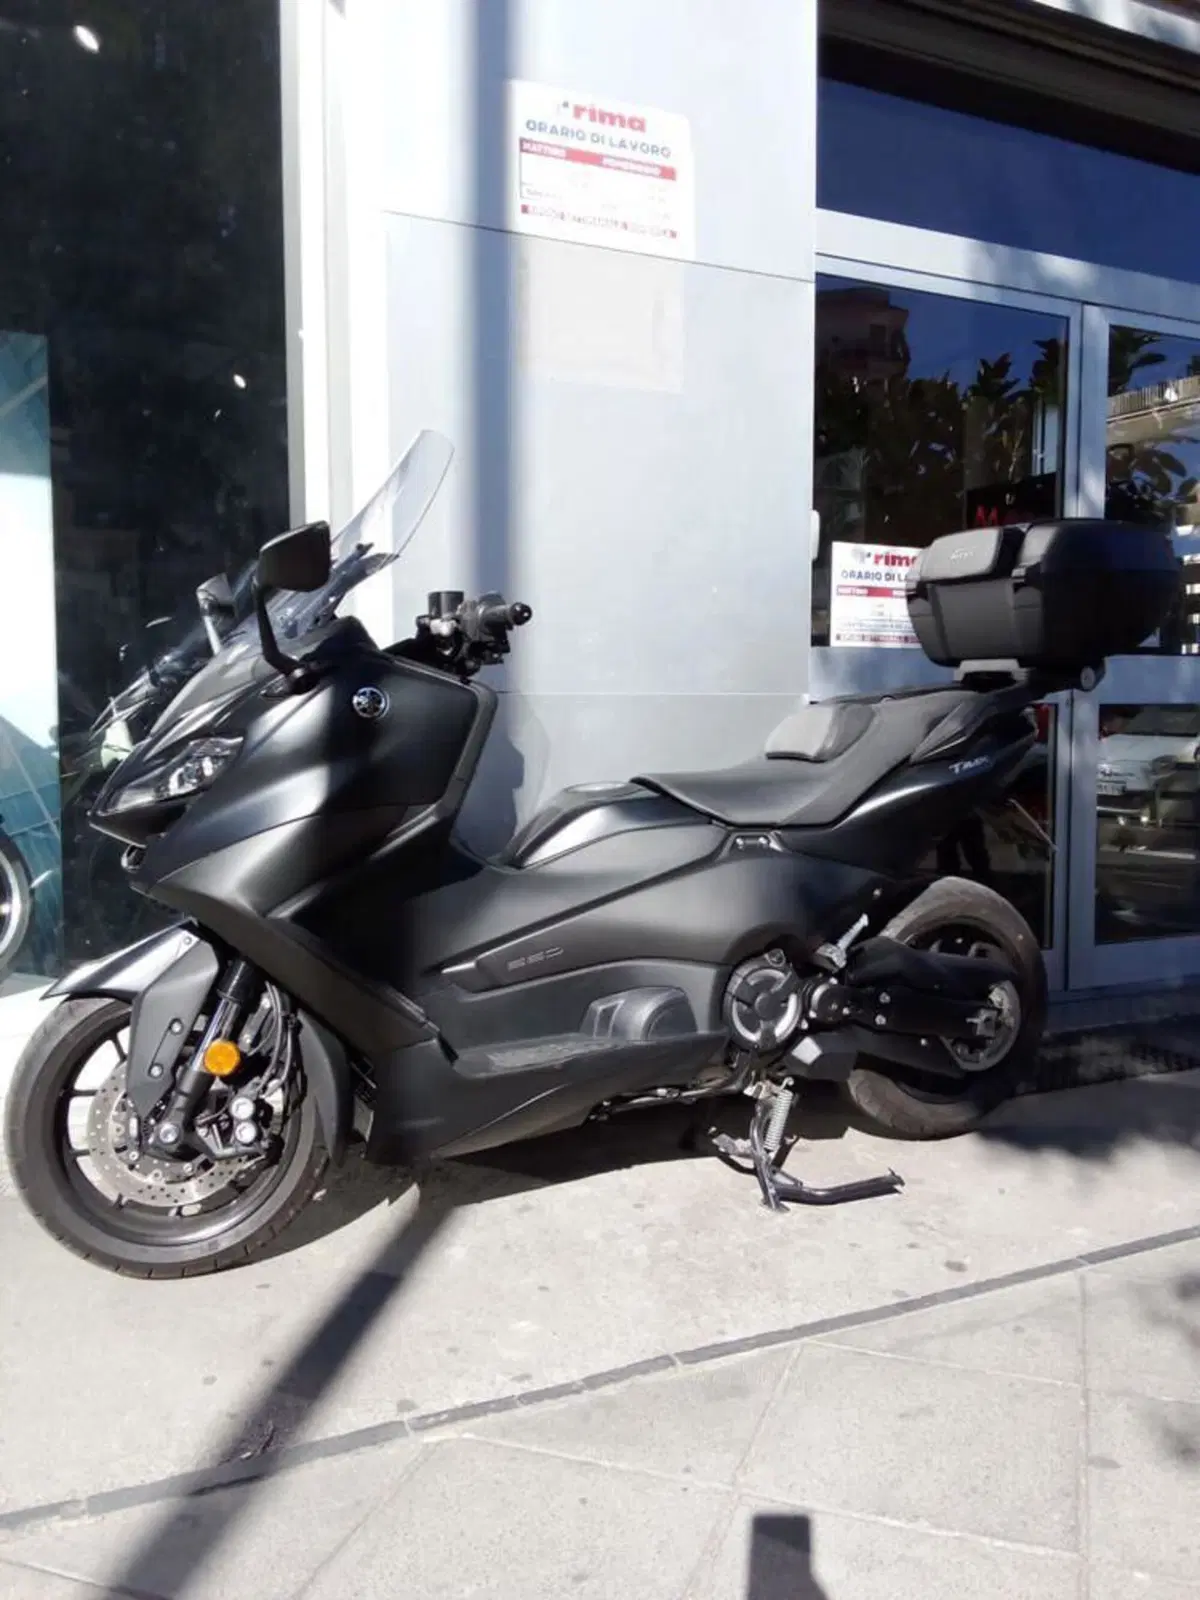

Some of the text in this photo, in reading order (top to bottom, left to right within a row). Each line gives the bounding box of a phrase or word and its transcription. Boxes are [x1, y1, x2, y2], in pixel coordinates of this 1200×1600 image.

[572, 103, 646, 133] rima
[525, 119, 671, 159] ORARIO DI LAVORO
[840, 568, 882, 582] ORARIO
[884, 572, 896, 583] DI
